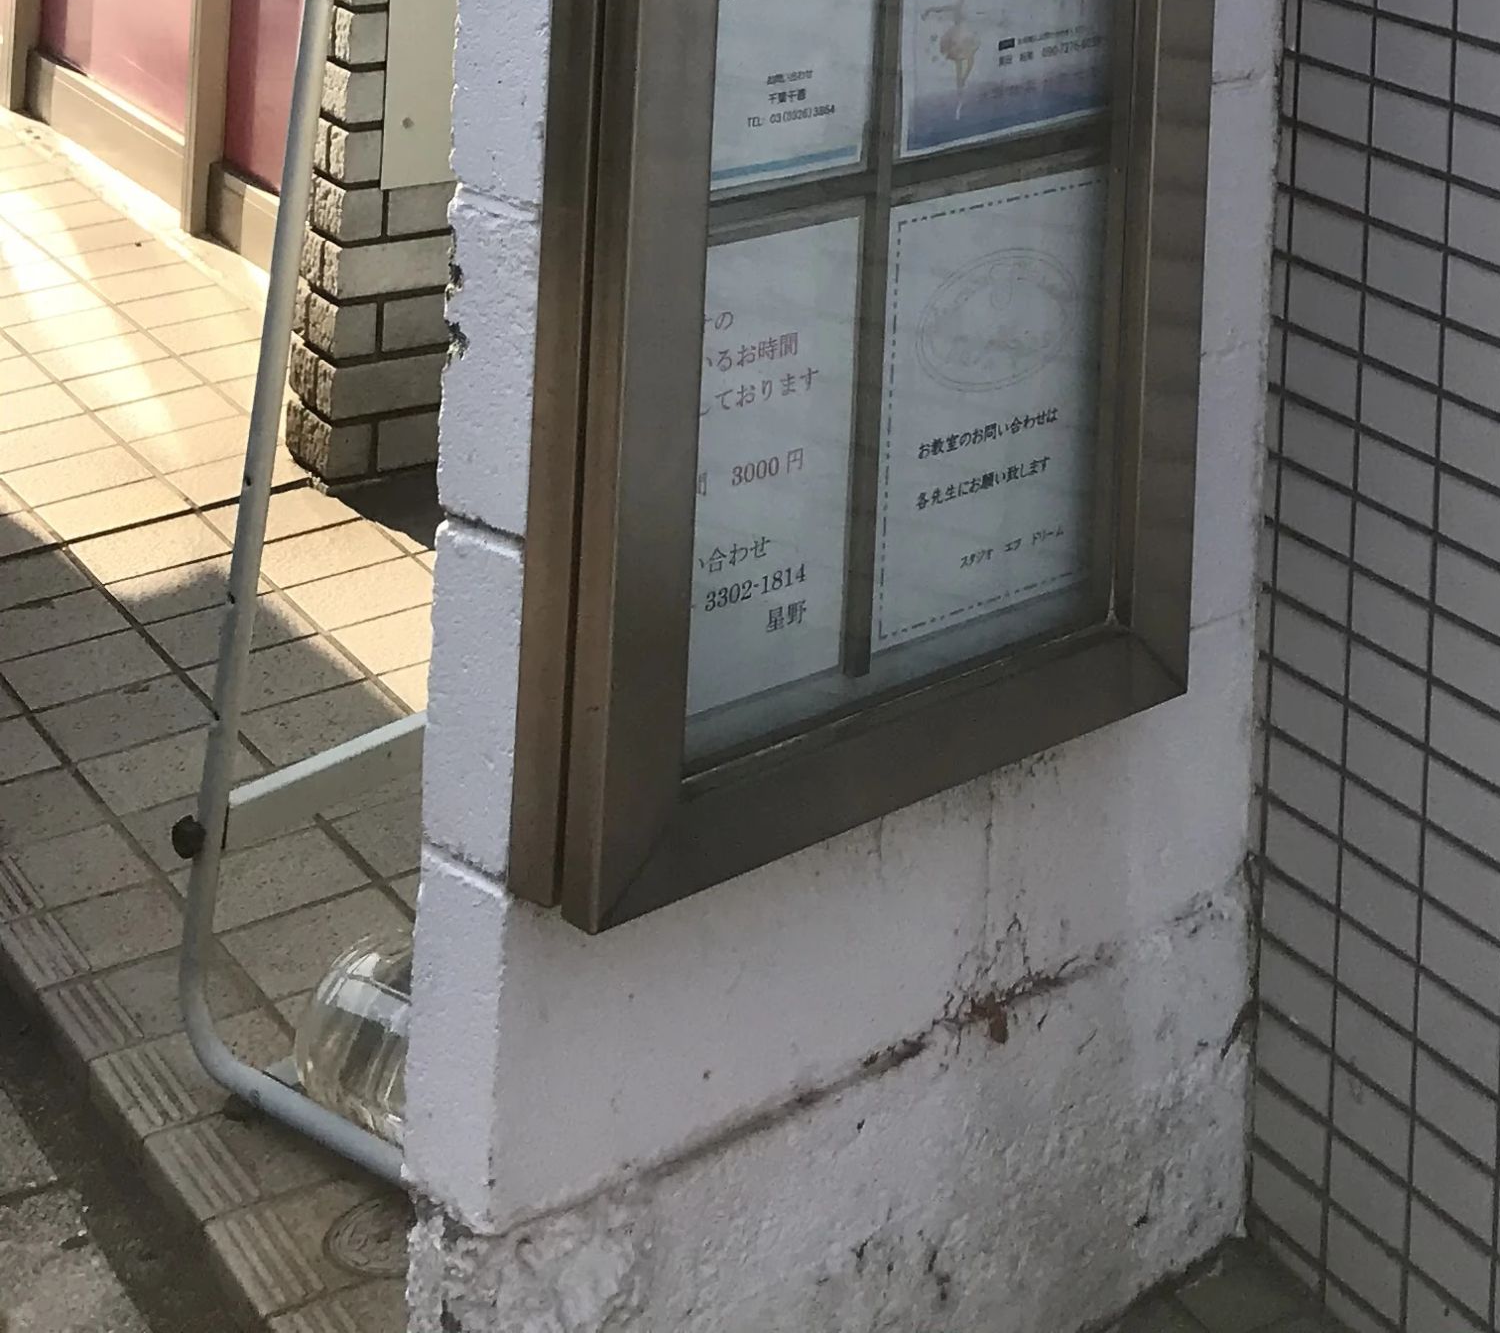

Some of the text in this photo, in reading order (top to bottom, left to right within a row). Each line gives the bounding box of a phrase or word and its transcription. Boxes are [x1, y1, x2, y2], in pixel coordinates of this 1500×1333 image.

[917, 406, 1060, 460] お教室のお問い合わせは
[731, 455, 780, 487] 3000
[786, 448, 805, 474] 円
[916, 456, 1051, 511] 各先生にお願い致します
[705, 563, 807, 612] 3302-1814
[766, 599, 808, 633] 星野
